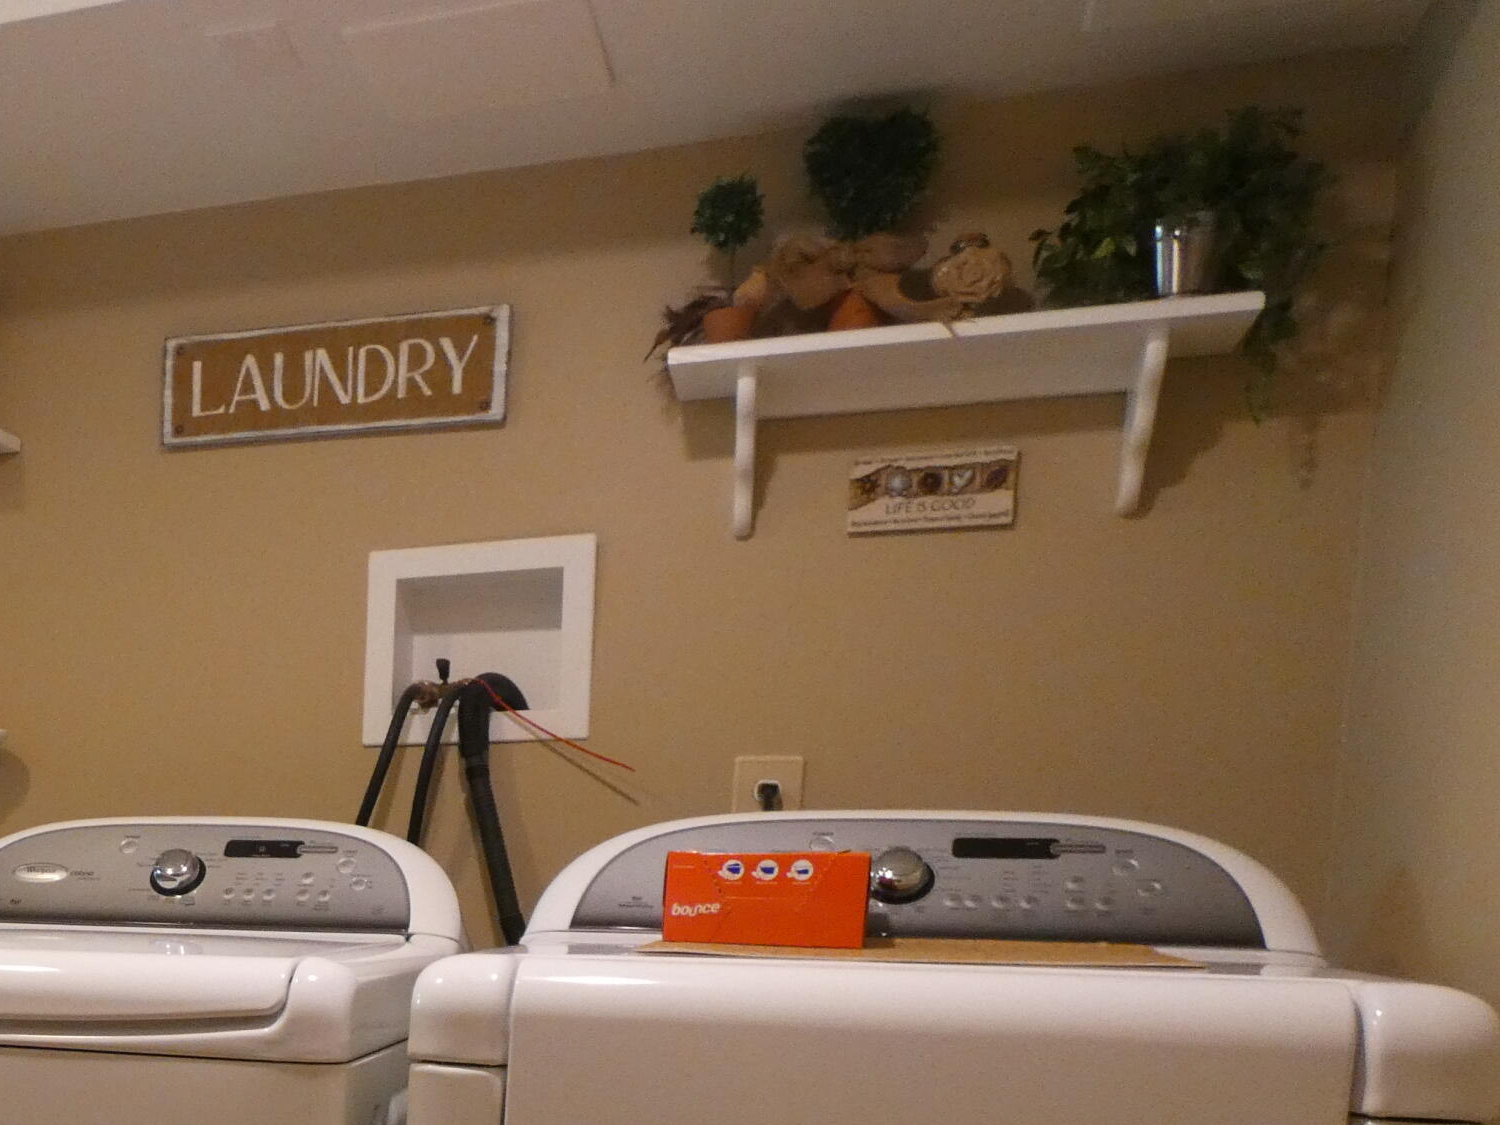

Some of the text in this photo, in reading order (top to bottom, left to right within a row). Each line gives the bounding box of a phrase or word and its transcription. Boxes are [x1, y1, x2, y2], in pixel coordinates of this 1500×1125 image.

[191, 334, 479, 418] LAUNDRY
[884, 500, 911, 515] LIFE
[930, 497, 977, 512] GOOD
[671, 900, 721, 917] bounce
